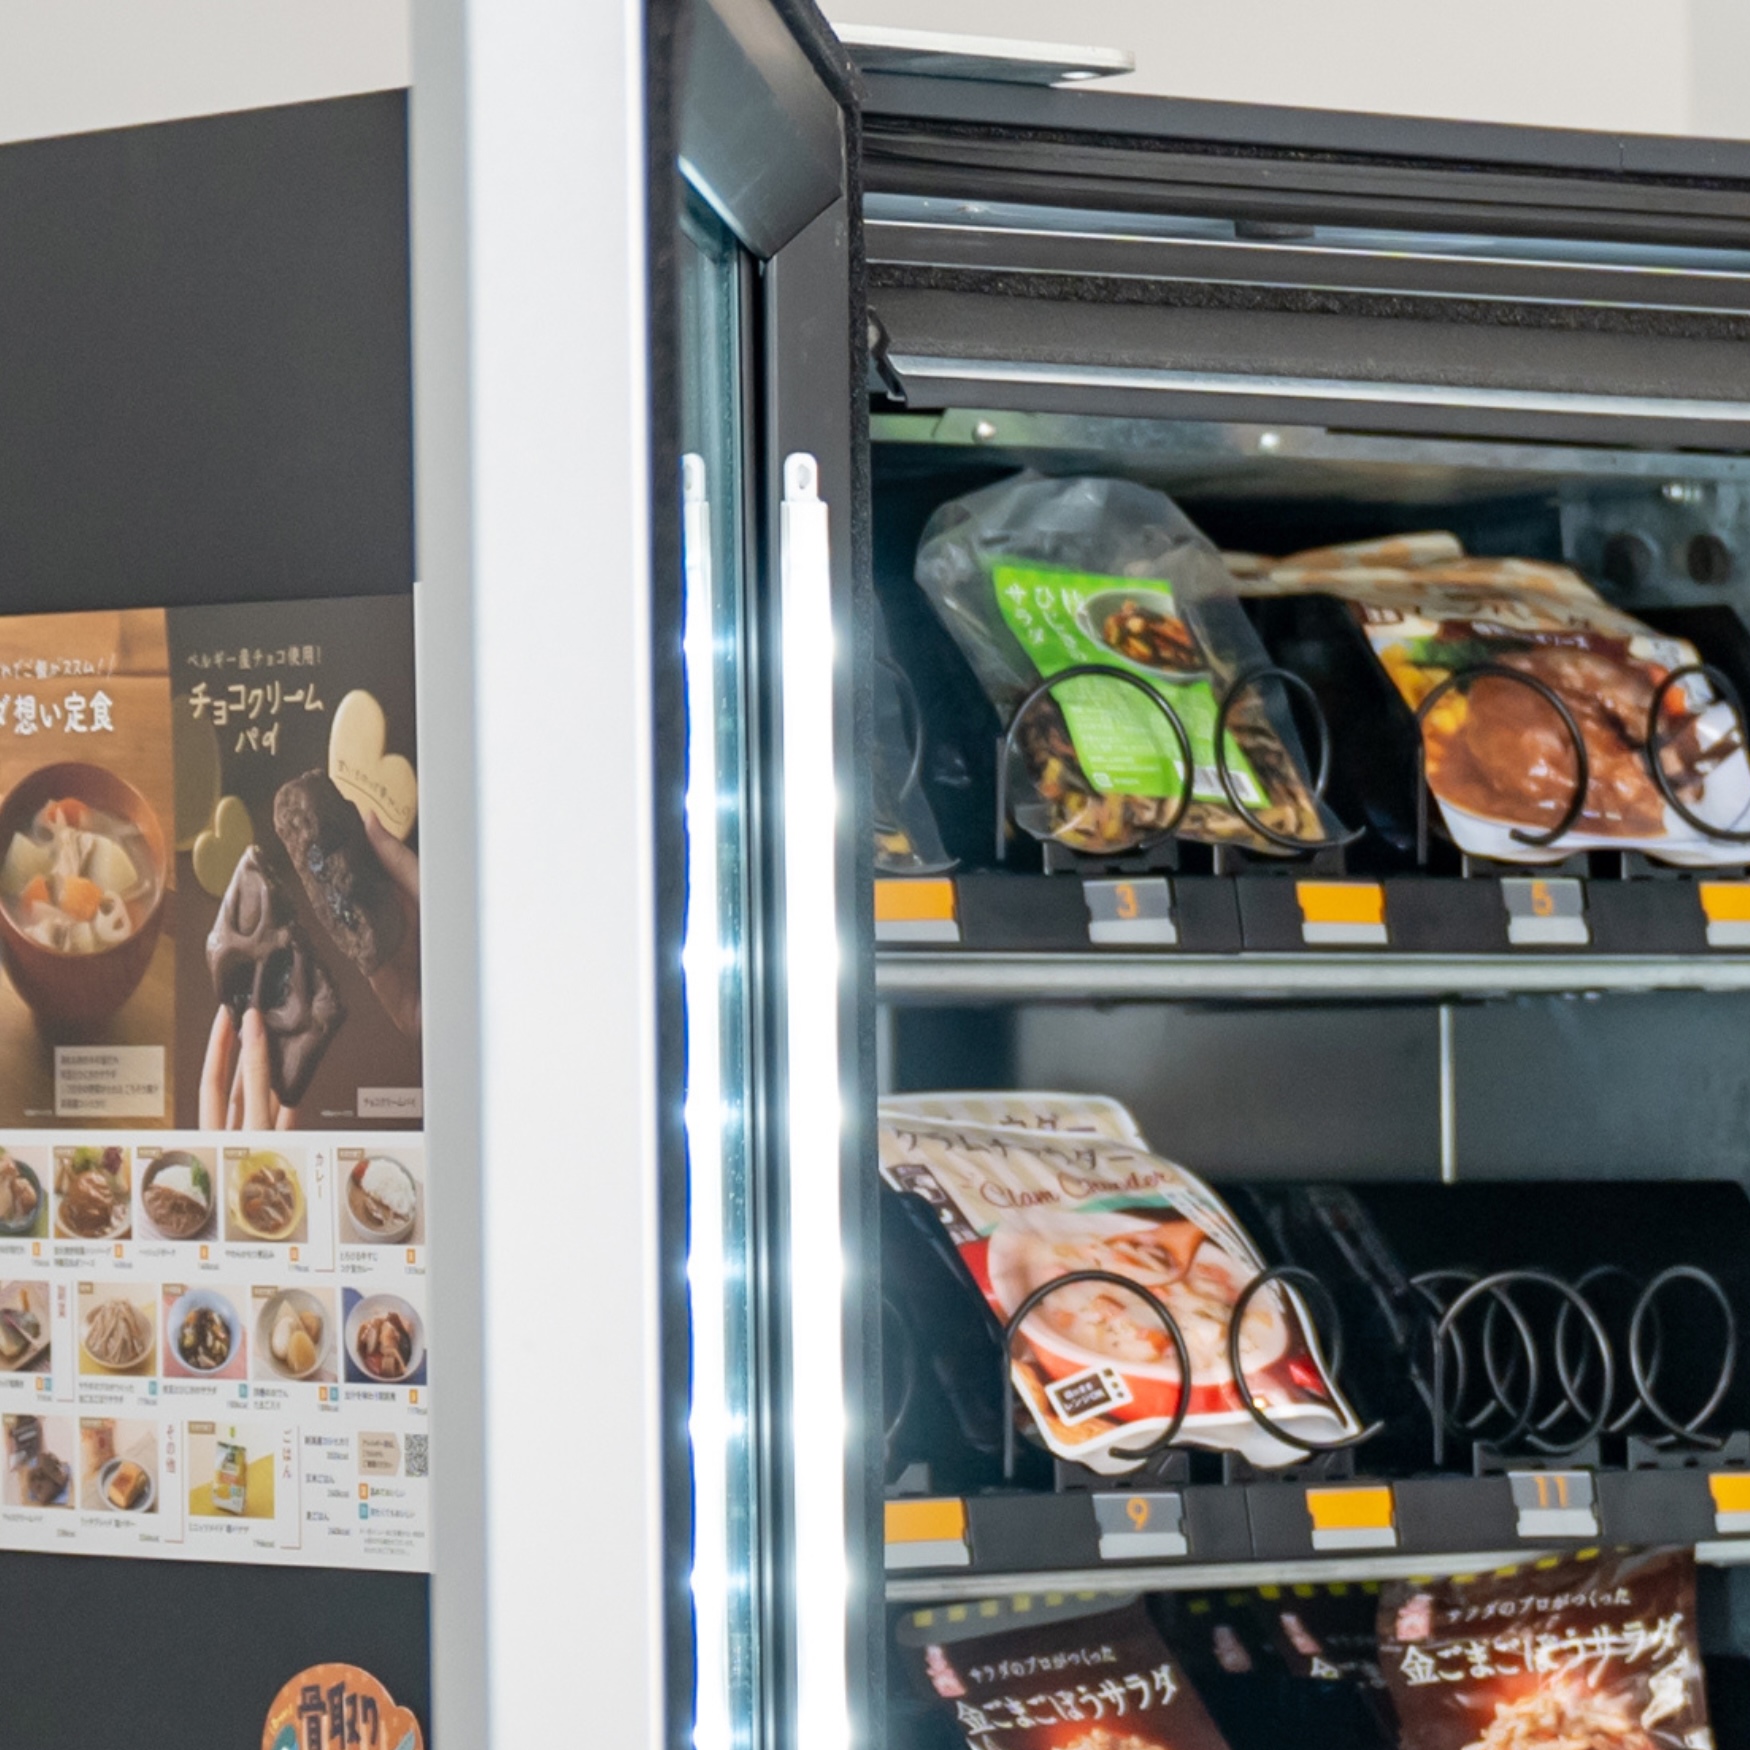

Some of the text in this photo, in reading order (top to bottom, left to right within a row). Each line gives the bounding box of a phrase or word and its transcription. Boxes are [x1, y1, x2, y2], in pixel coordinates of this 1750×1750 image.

[189, 680, 325, 726] チョコクリーム
[234, 721, 279, 756] パイ
[1115, 883, 1139, 919] 3
[1531, 881, 1553, 916] 5
[980, 1182, 1060, 1209] Clam
[1534, 1476, 1568, 1508] 11
[1126, 1497, 1149, 1530] 9
[956, 1663, 1178, 1736] 金ごまごぼうサラダ
